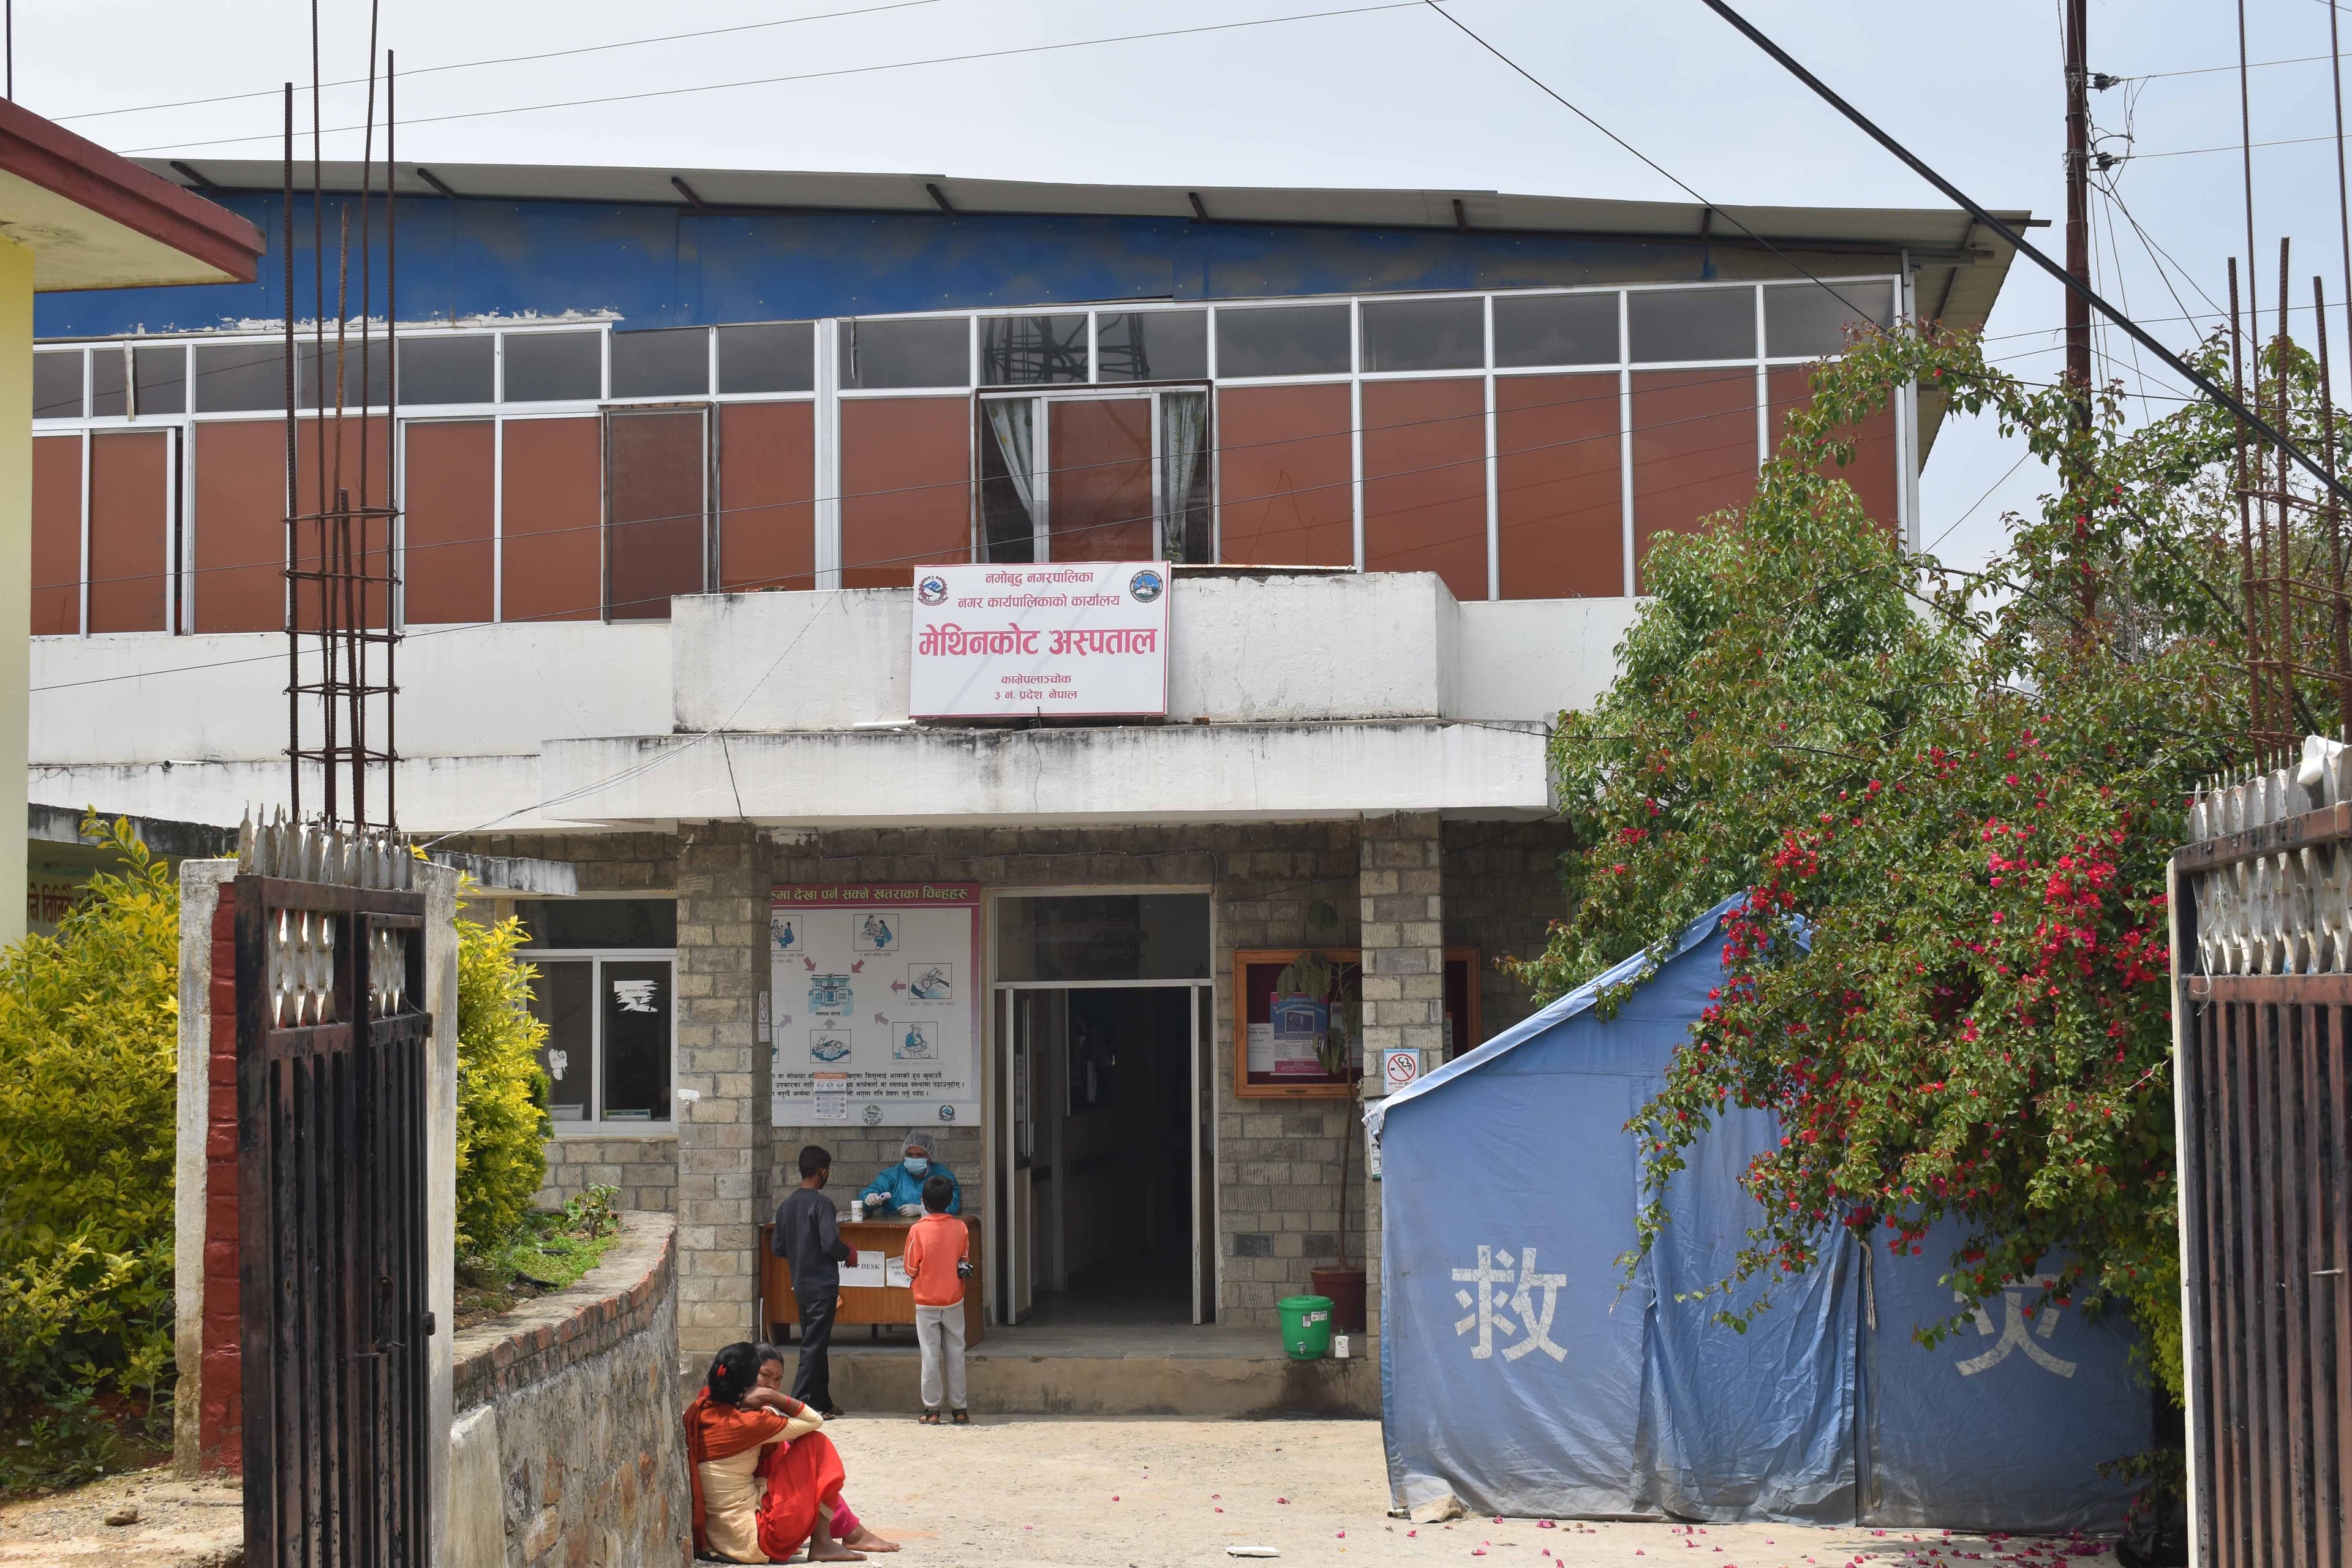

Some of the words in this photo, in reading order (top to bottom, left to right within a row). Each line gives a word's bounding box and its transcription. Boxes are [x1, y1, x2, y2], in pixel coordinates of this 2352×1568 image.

[986, 570, 1023, 587] नमोबुद्ध
[1027, 569, 1094, 583] नगरपालिका
[958, 598, 984, 608] नगर
[987, 594, 1068, 608] कार्यपालिकाको
[1071, 593, 1121, 606] कार्यालय
[919, 622, 1041, 657] मेथिनकोट
[1049, 628, 1158, 657] अस्पताल
[994, 692, 1000, 700] ३
[1049, 688, 1078, 699] नेपाल
[794, 888, 818, 900] देखा
[821, 887, 838, 900] पर्न
[842, 887, 869, 900] सक्ने
[873, 889, 919, 900] खतराका
[1452, 1244, 1568, 1362] 救
